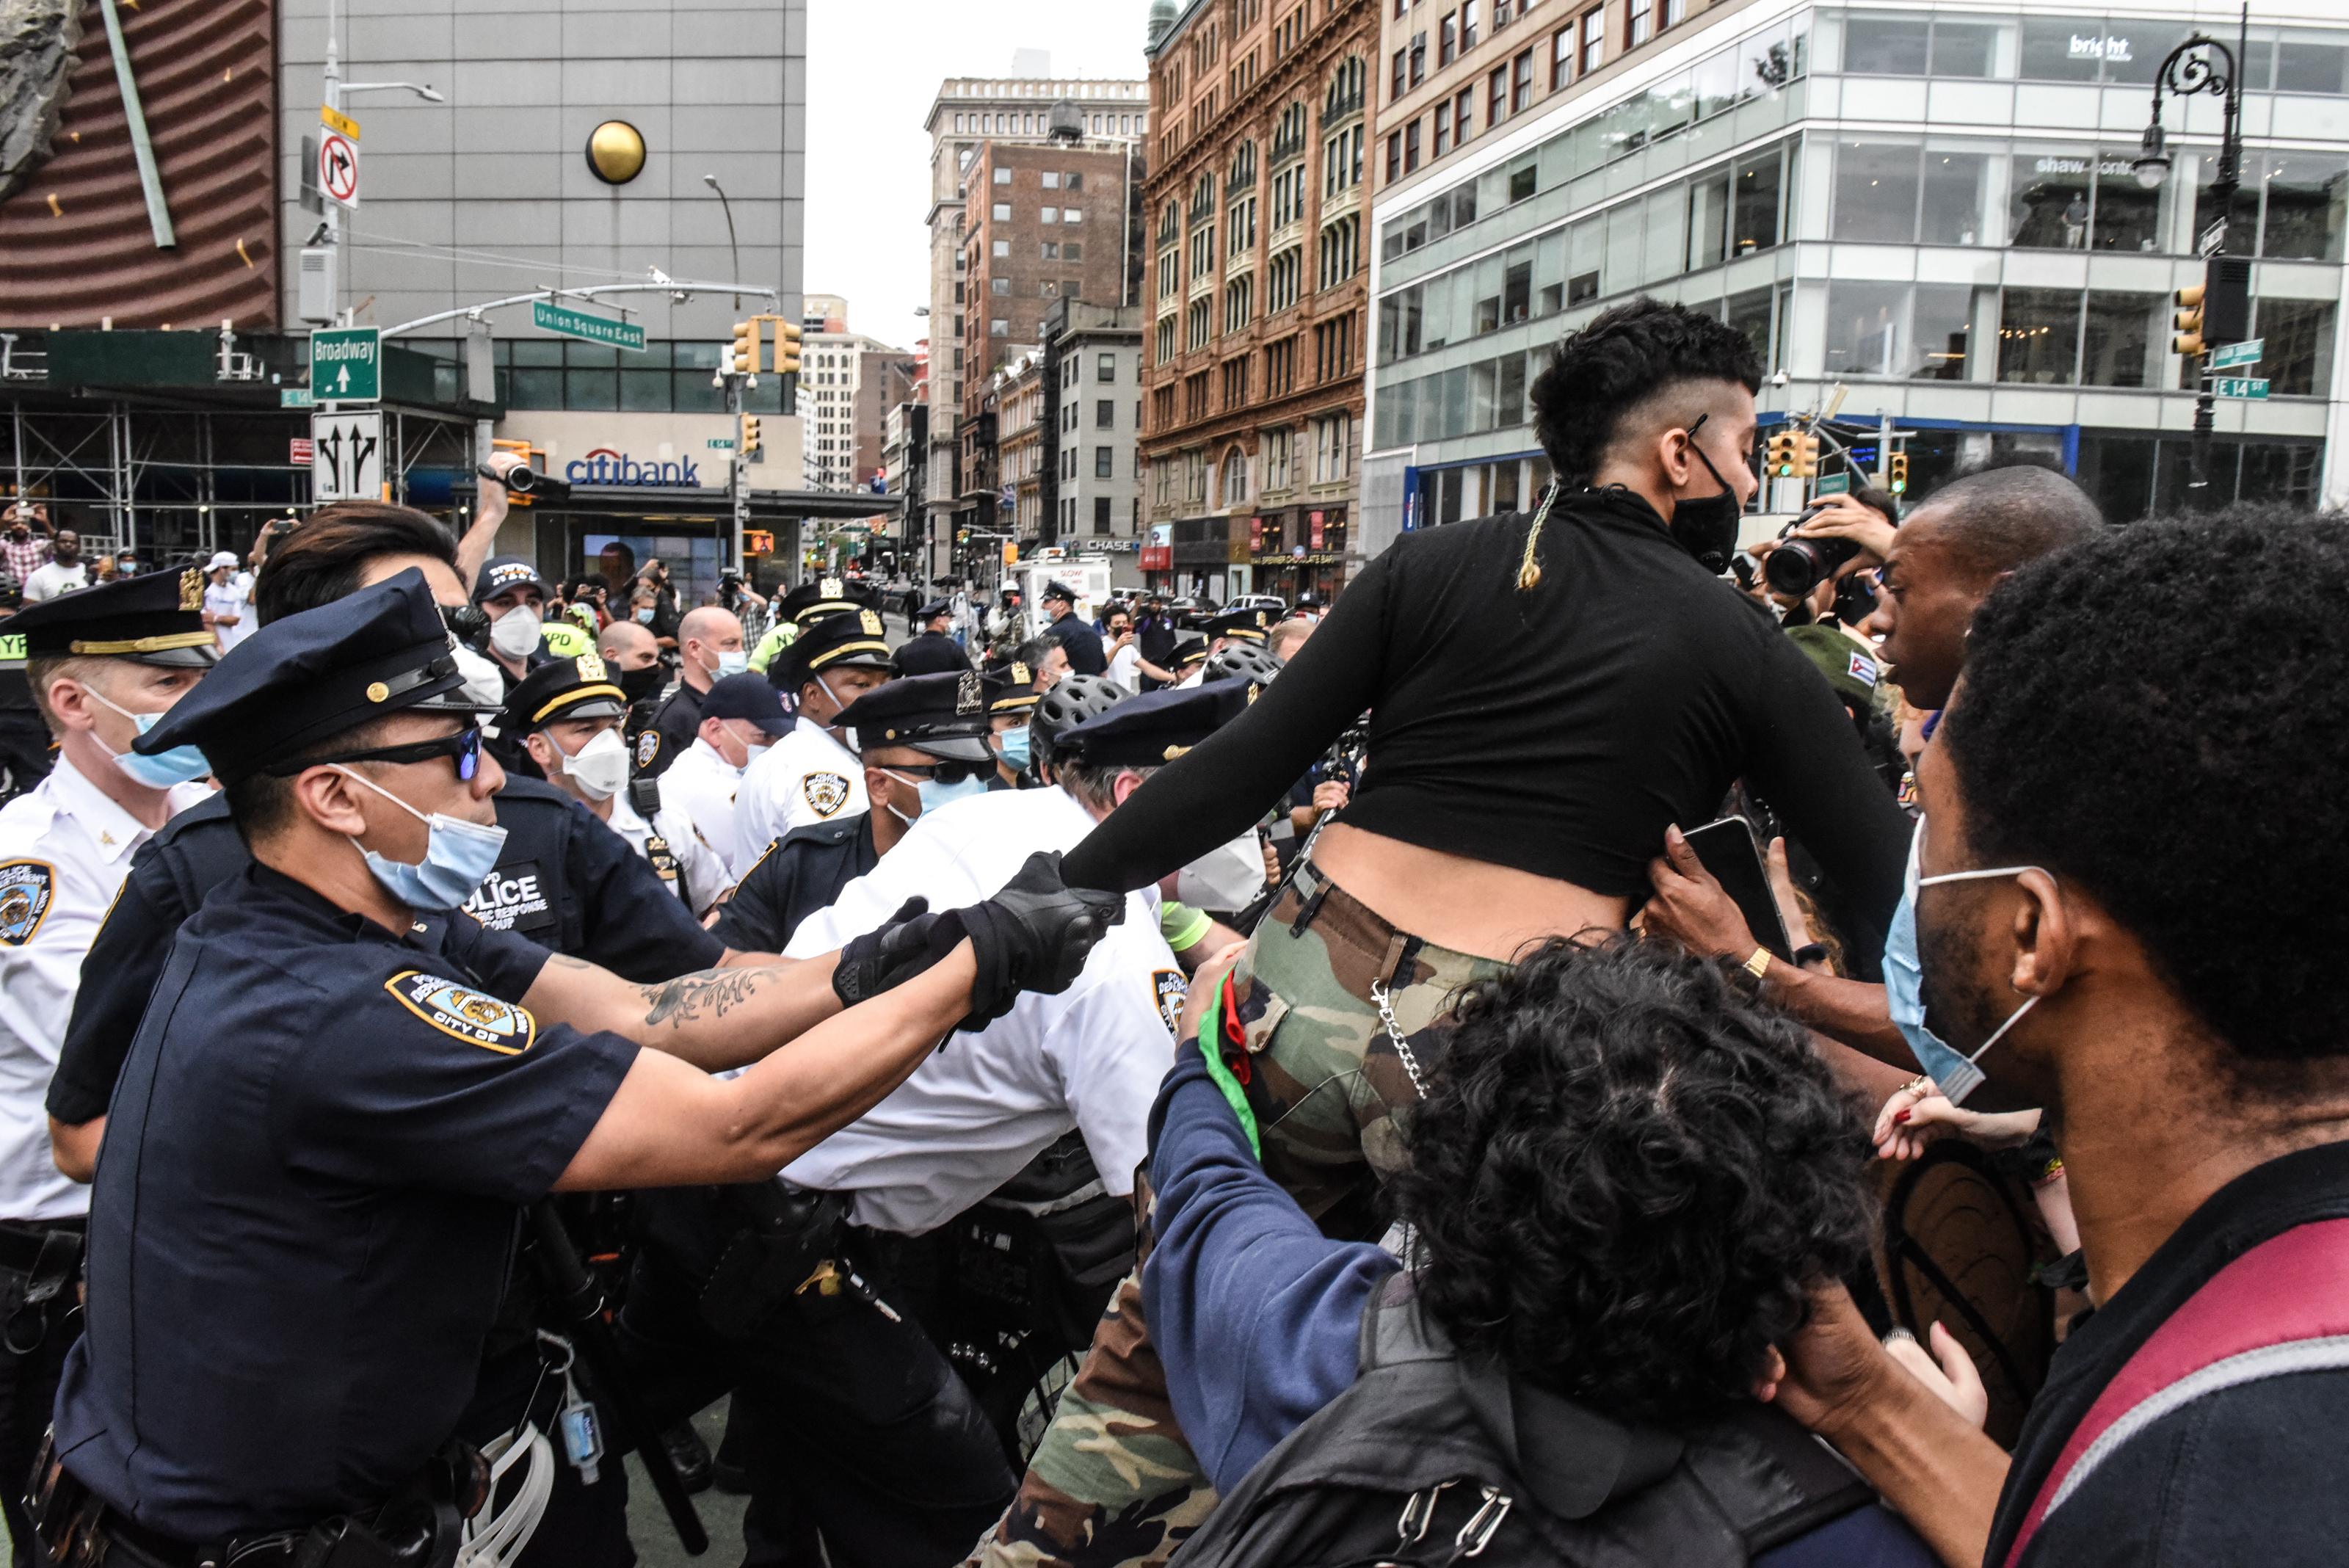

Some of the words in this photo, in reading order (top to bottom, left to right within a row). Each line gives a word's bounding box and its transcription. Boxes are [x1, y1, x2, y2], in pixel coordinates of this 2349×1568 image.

[2036, 157, 2085, 173] shaw
[537, 308, 571, 329] Union
[573, 317, 613, 338] Square
[615, 327, 642, 344] East
[315, 337, 375, 365] Broadway
[2218, 380, 2229, 396] E
[2232, 380, 2248, 397] 14
[566, 451, 700, 487] citibank
[1087, 540, 1131, 551] CHASE
[494, 898, 549, 920] RESPONSE
[433, 1011, 473, 1034] CITY
[474, 1028, 499, 1043] OF
